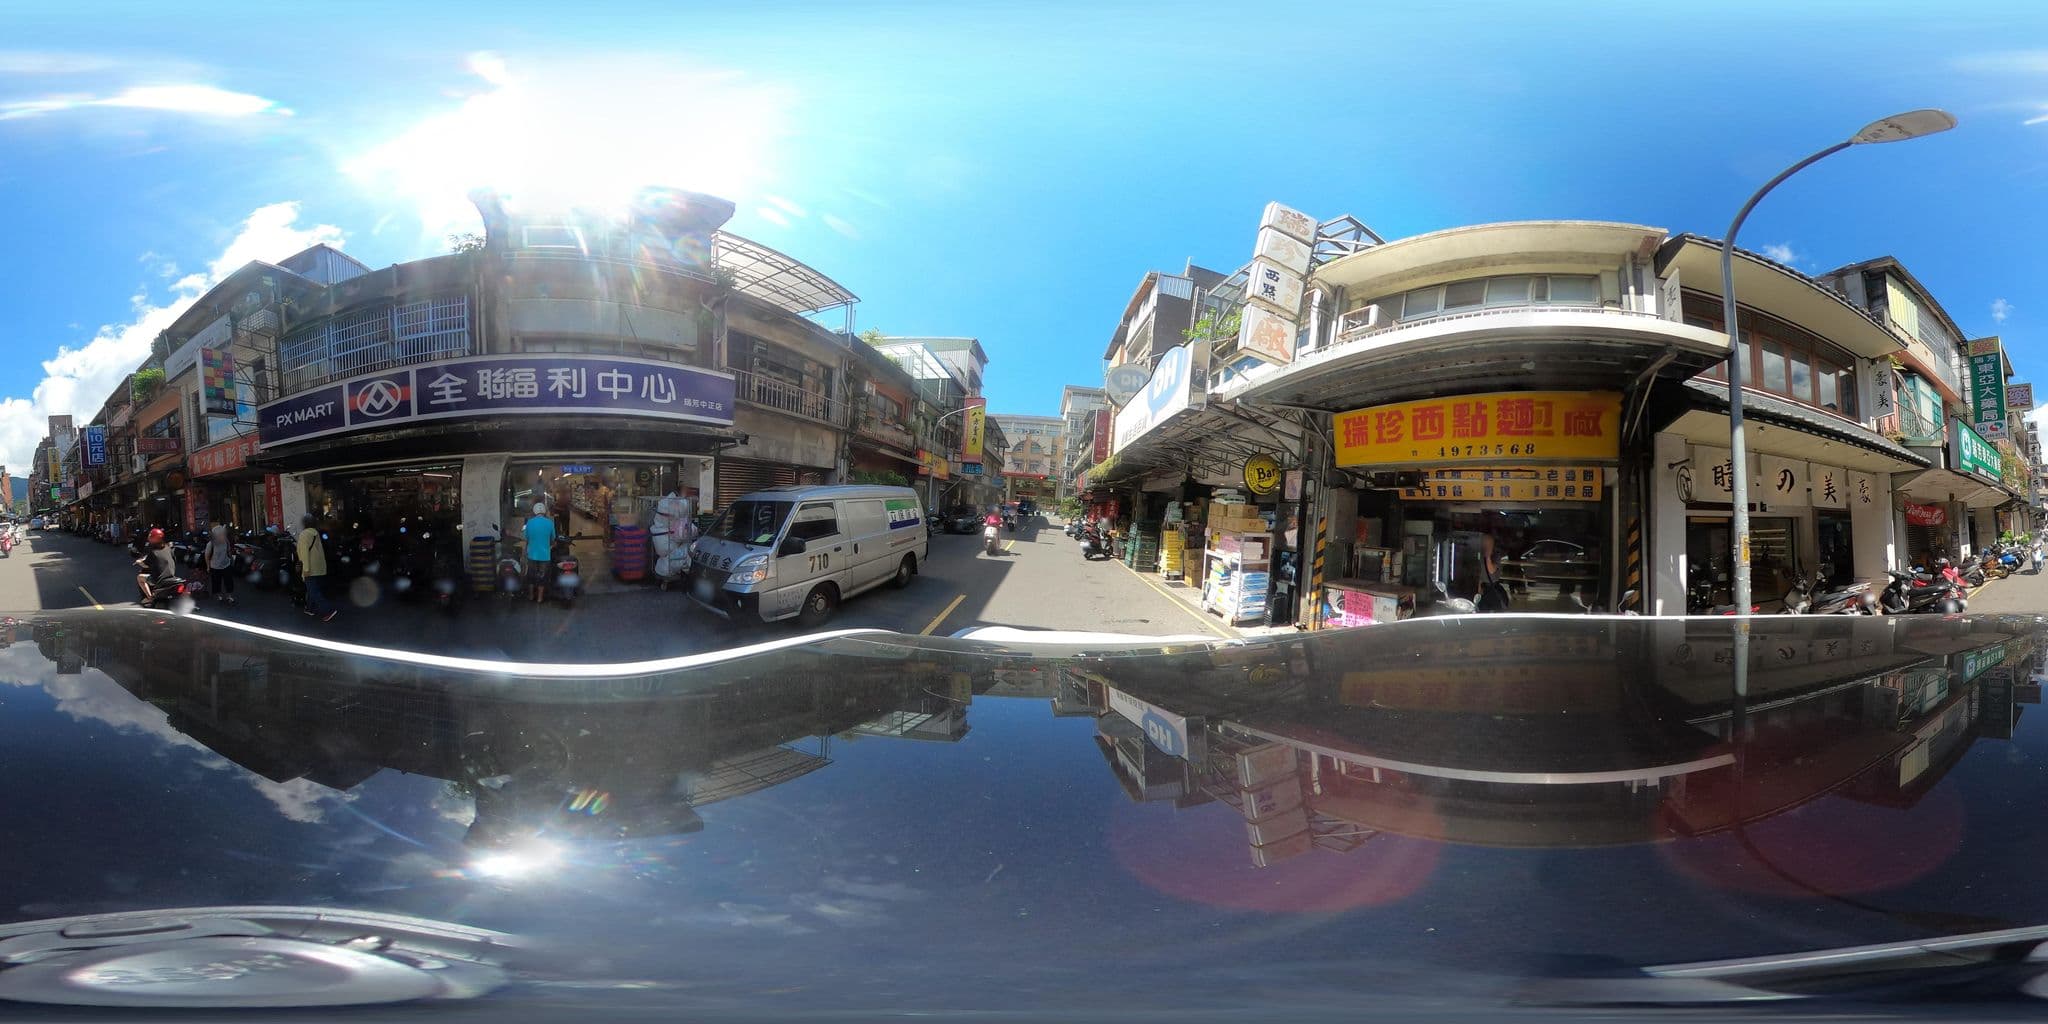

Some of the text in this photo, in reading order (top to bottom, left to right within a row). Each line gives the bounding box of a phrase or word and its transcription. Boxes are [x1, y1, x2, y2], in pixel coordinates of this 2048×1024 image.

[428, 366, 677, 405] 全聯福利中心
[1977, 363, 1999, 422] 東亞大藥局
[276, 401, 335, 429] PX MART
[1438, 442, 1535, 457] 4973568
[1256, 466, 1276, 480] Bar
[808, 552, 829, 574] 710
